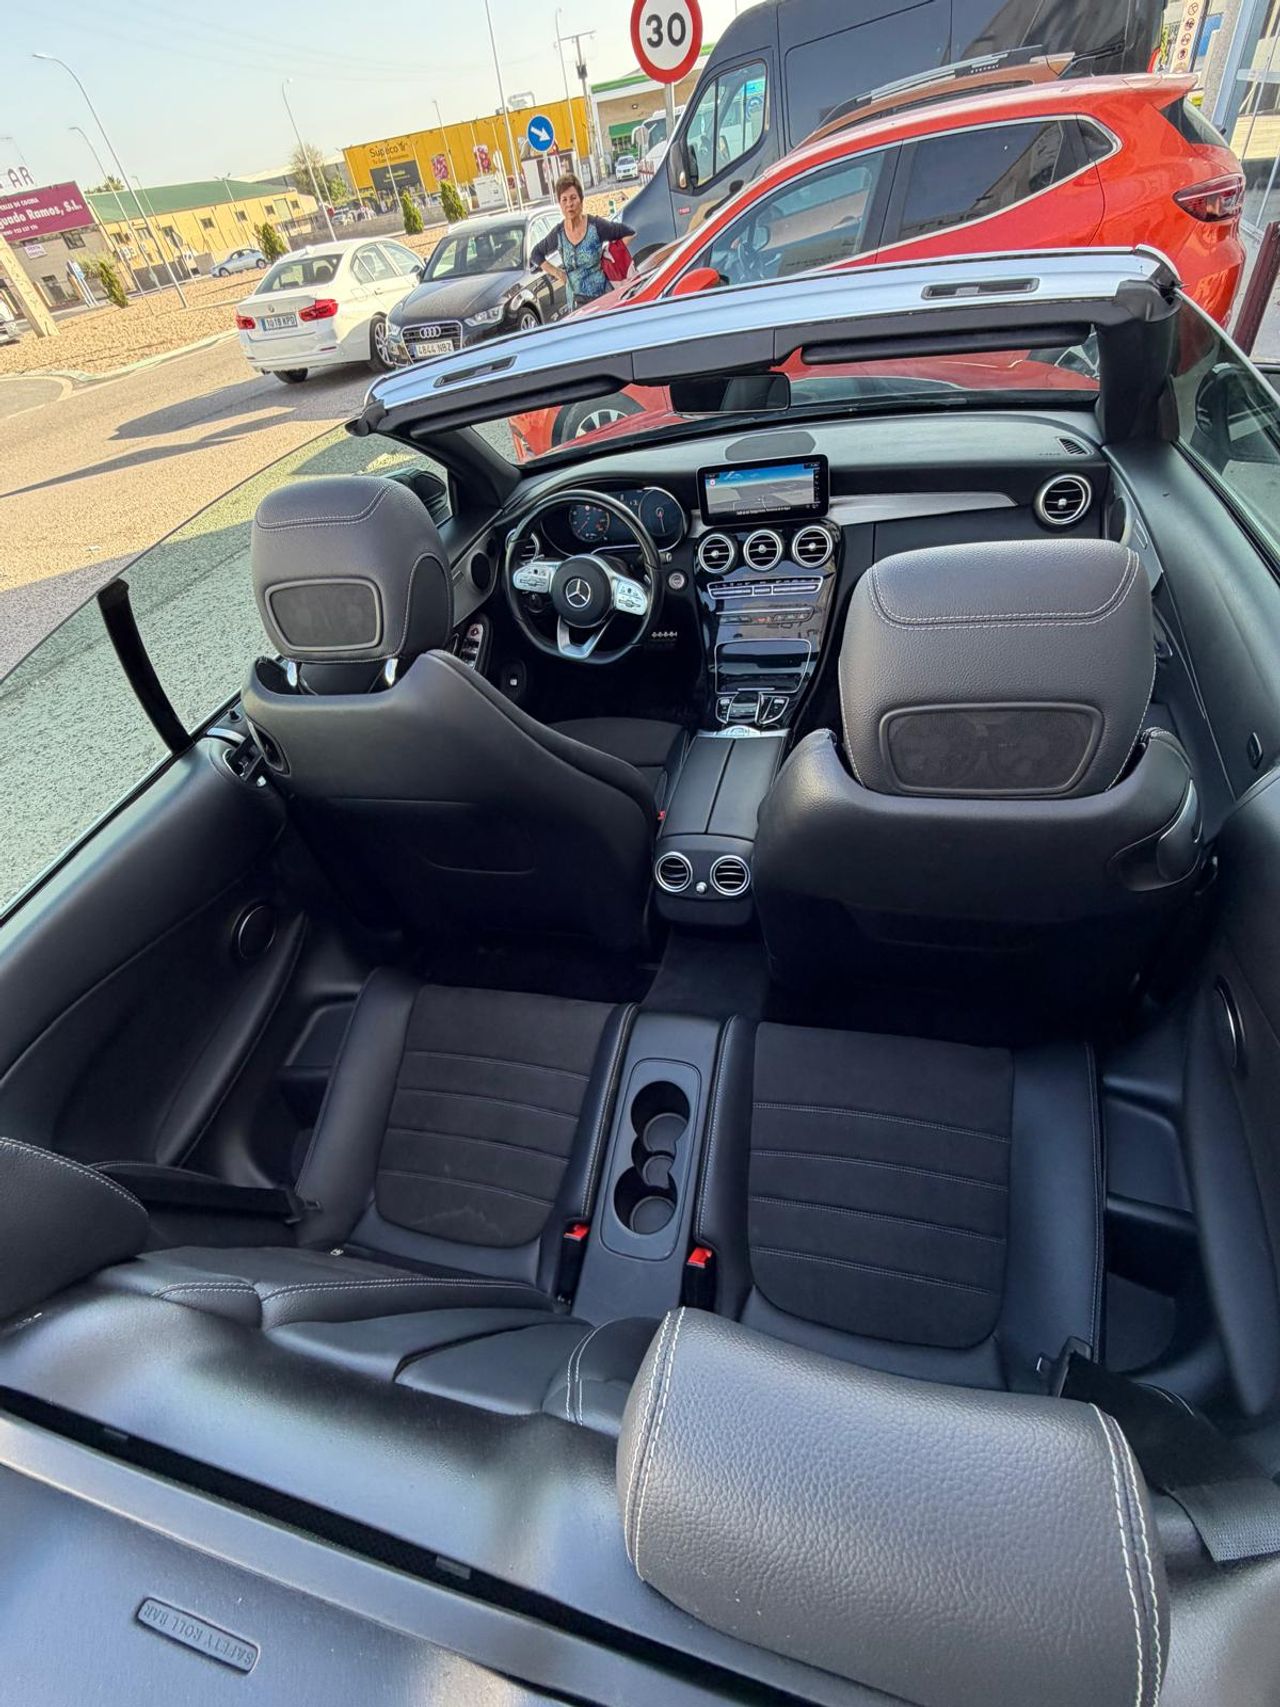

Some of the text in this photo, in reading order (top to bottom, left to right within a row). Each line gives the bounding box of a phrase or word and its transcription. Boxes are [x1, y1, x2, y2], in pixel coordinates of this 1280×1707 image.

[646, 12, 686, 48] 30
[143, 1604, 254, 1665] SAFETY ROLL BAR
